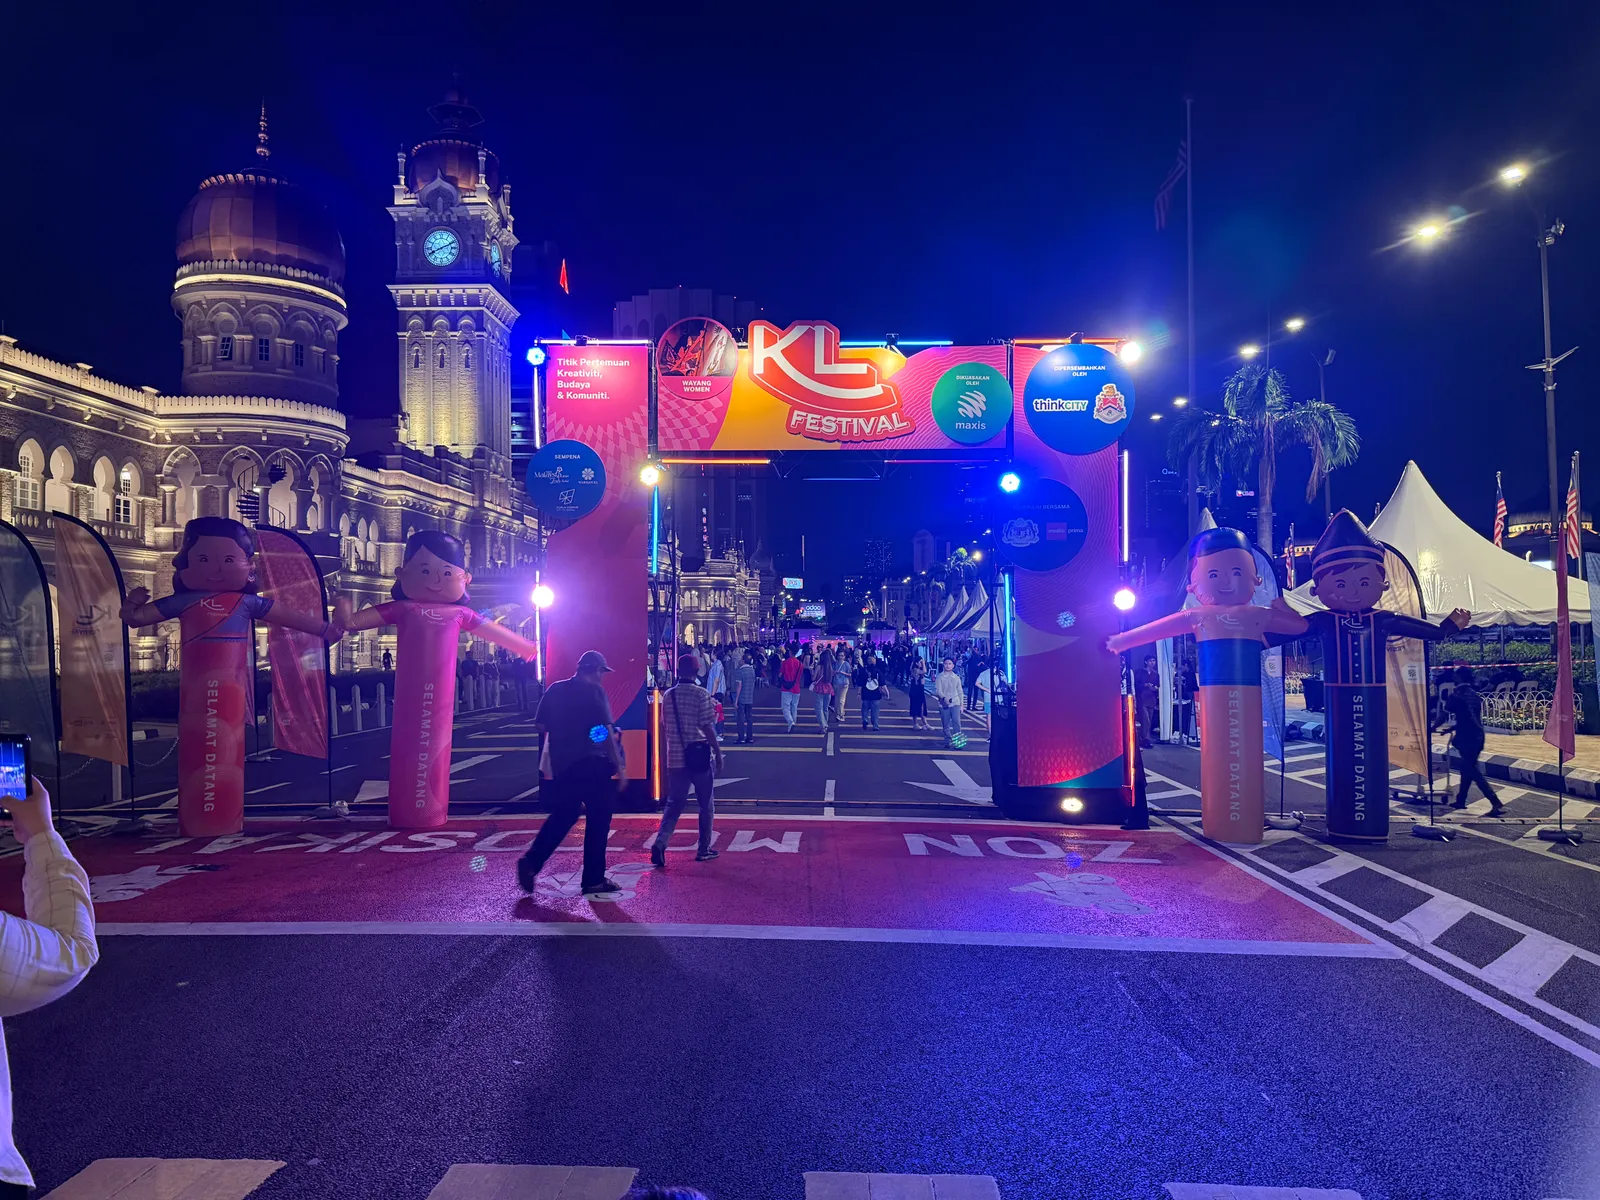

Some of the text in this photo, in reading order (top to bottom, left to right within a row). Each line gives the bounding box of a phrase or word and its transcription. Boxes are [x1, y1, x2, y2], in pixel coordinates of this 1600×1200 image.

[557, 358, 630, 366] Titik Pertemuan
[752, 324, 886, 401] KL
[557, 369, 603, 378] Kreativiti,
[557, 380, 591, 390] Budaya
[557, 391, 610, 399] & Komuniti.
[1033, 399, 1088, 411] thinkCITY
[790, 409, 910, 436] FESTIVAL
[955, 420, 987, 430] maxis
[200, 598, 225, 611] KL
[421, 608, 443, 620] KL
[1216, 613, 1240, 625] KL
[1341, 617, 1365, 629] KL
[203, 679, 219, 812] SELAMAT DATANG
[415, 683, 434, 808] SELAMAT DATANG
[1228, 690, 1240, 821] SELAMAT DATANG
[1352, 695, 1366, 821] SELAMAT DATANG
[902, 832, 1162, 865] ZON
